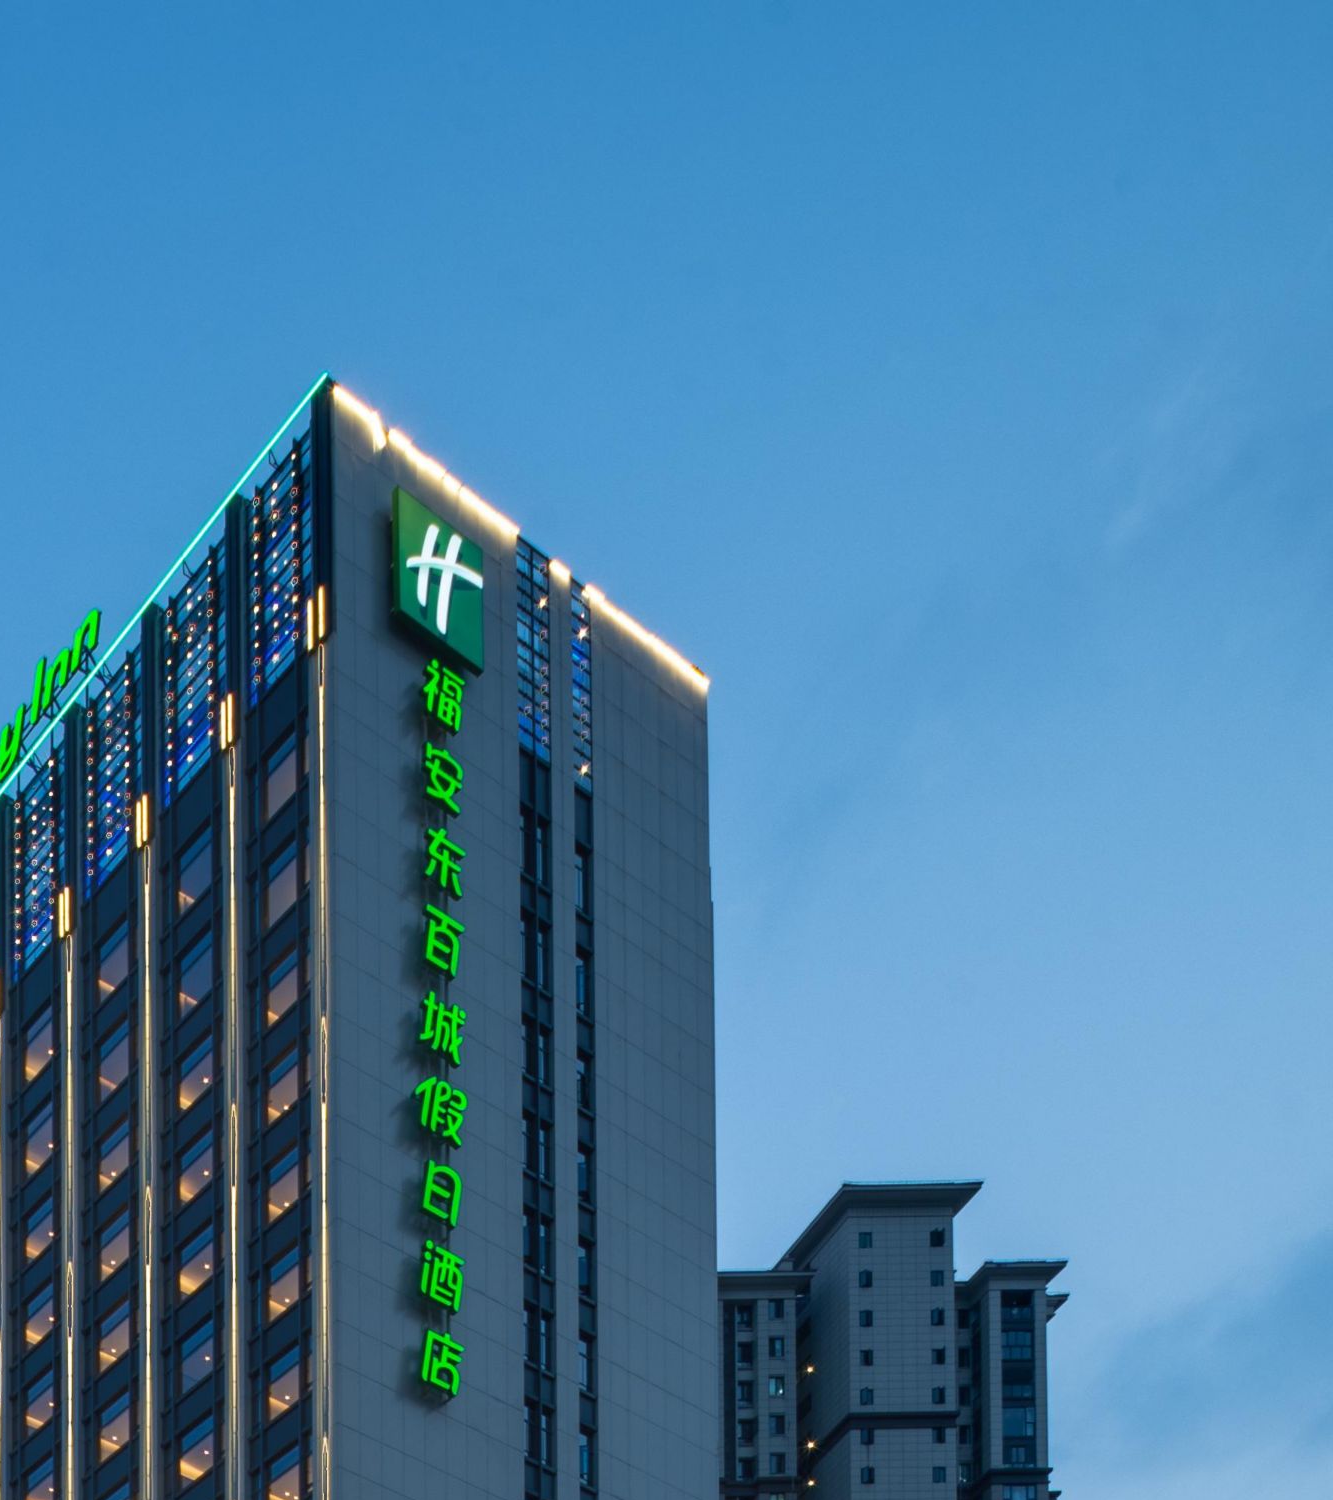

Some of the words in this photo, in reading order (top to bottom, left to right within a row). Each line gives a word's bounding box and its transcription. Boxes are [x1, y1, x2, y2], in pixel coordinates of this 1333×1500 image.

[29, 609, 100, 726] Inn
[415, 658, 468, 1396] 福安东百城假日酒店
